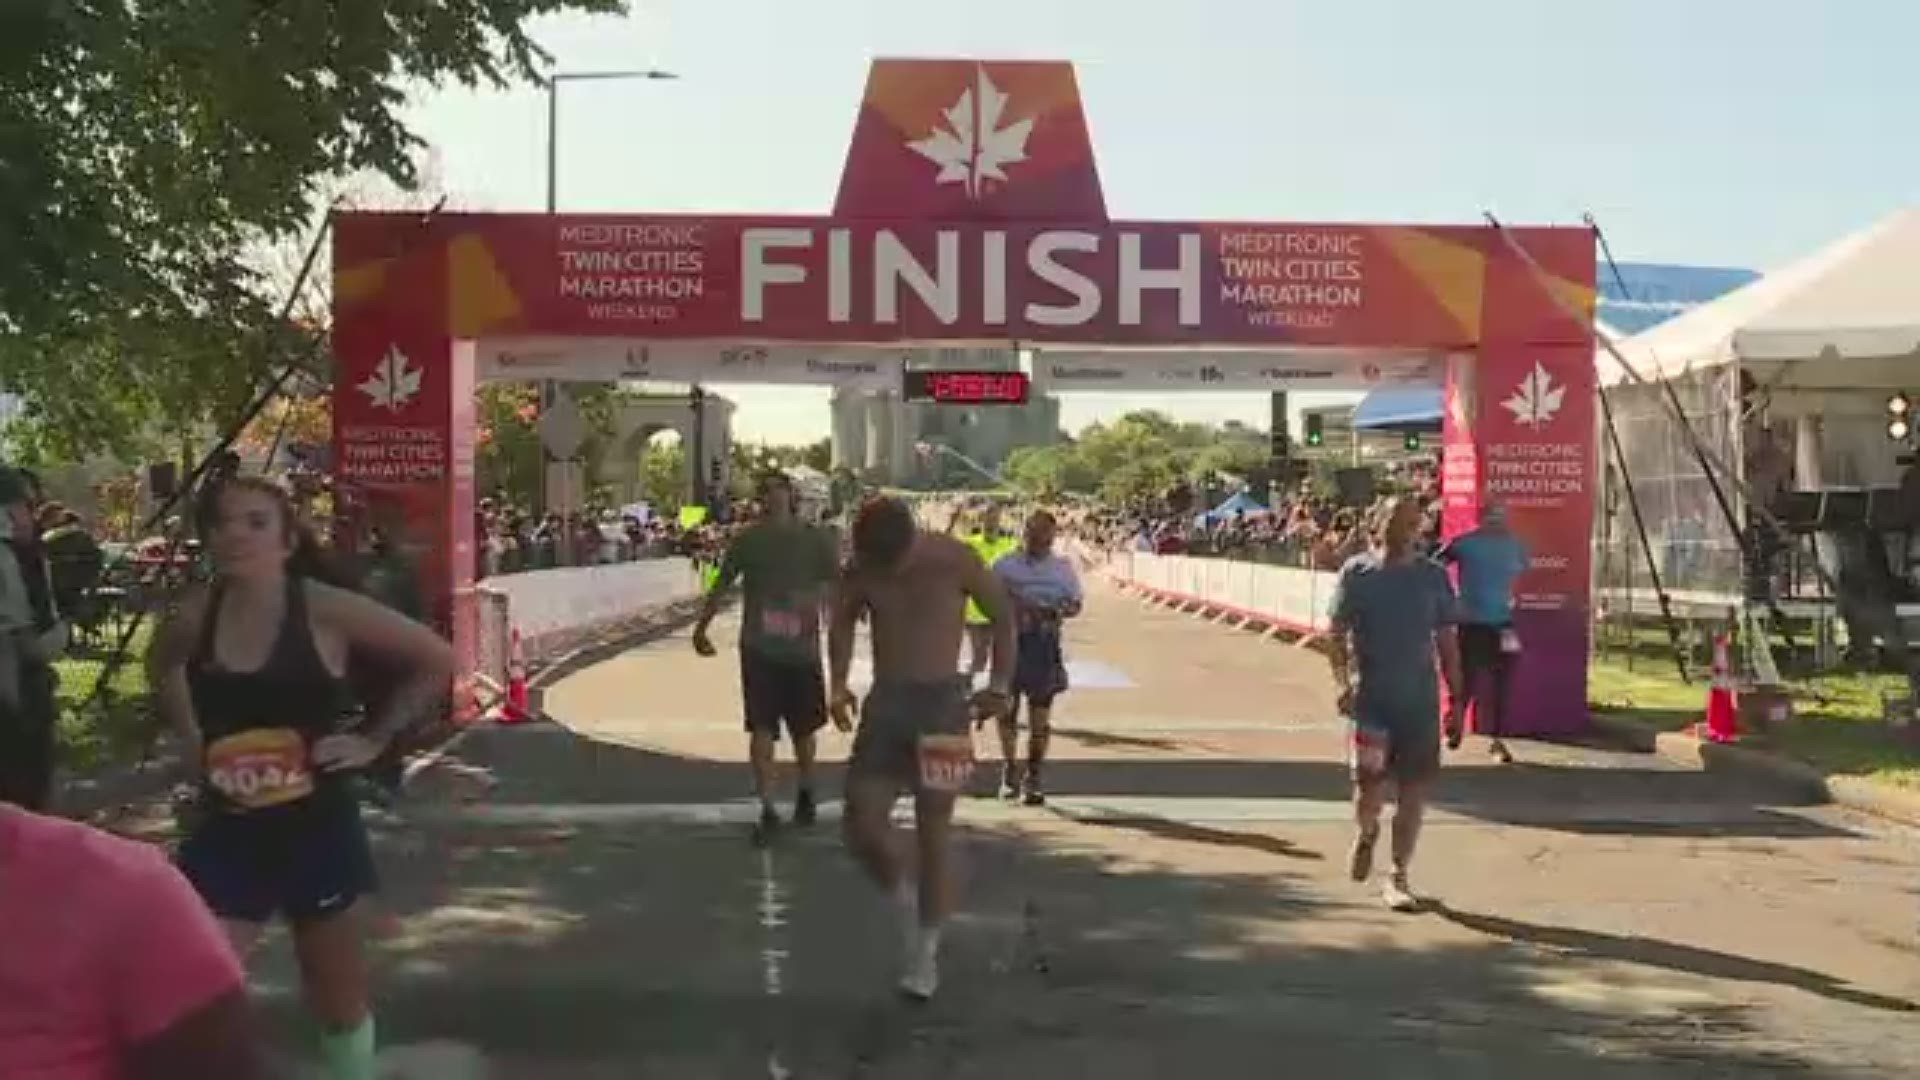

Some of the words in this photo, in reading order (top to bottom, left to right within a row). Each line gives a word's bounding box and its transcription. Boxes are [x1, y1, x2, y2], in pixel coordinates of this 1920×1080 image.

[560, 225, 704, 246] MEDTRONIC
[1220, 232, 1362, 254] MEDTRONIC
[559, 251, 620, 270] TWIN
[624, 251, 704, 271] CITIES
[1220, 257, 1281, 278] TWIN
[1286, 260, 1361, 279] CITIES
[560, 275, 704, 298] MARATHON
[741, 228, 1201, 326] FINISH
[1220, 283, 1361, 305] MARATHON
[388, 444, 444, 460] CITIES
[341, 461, 445, 477] MARATHON
[1487, 460, 1528, 475] TWIN
[1530, 461, 1582, 475] CITIES
[1487, 479, 1583, 493] MARATHON
